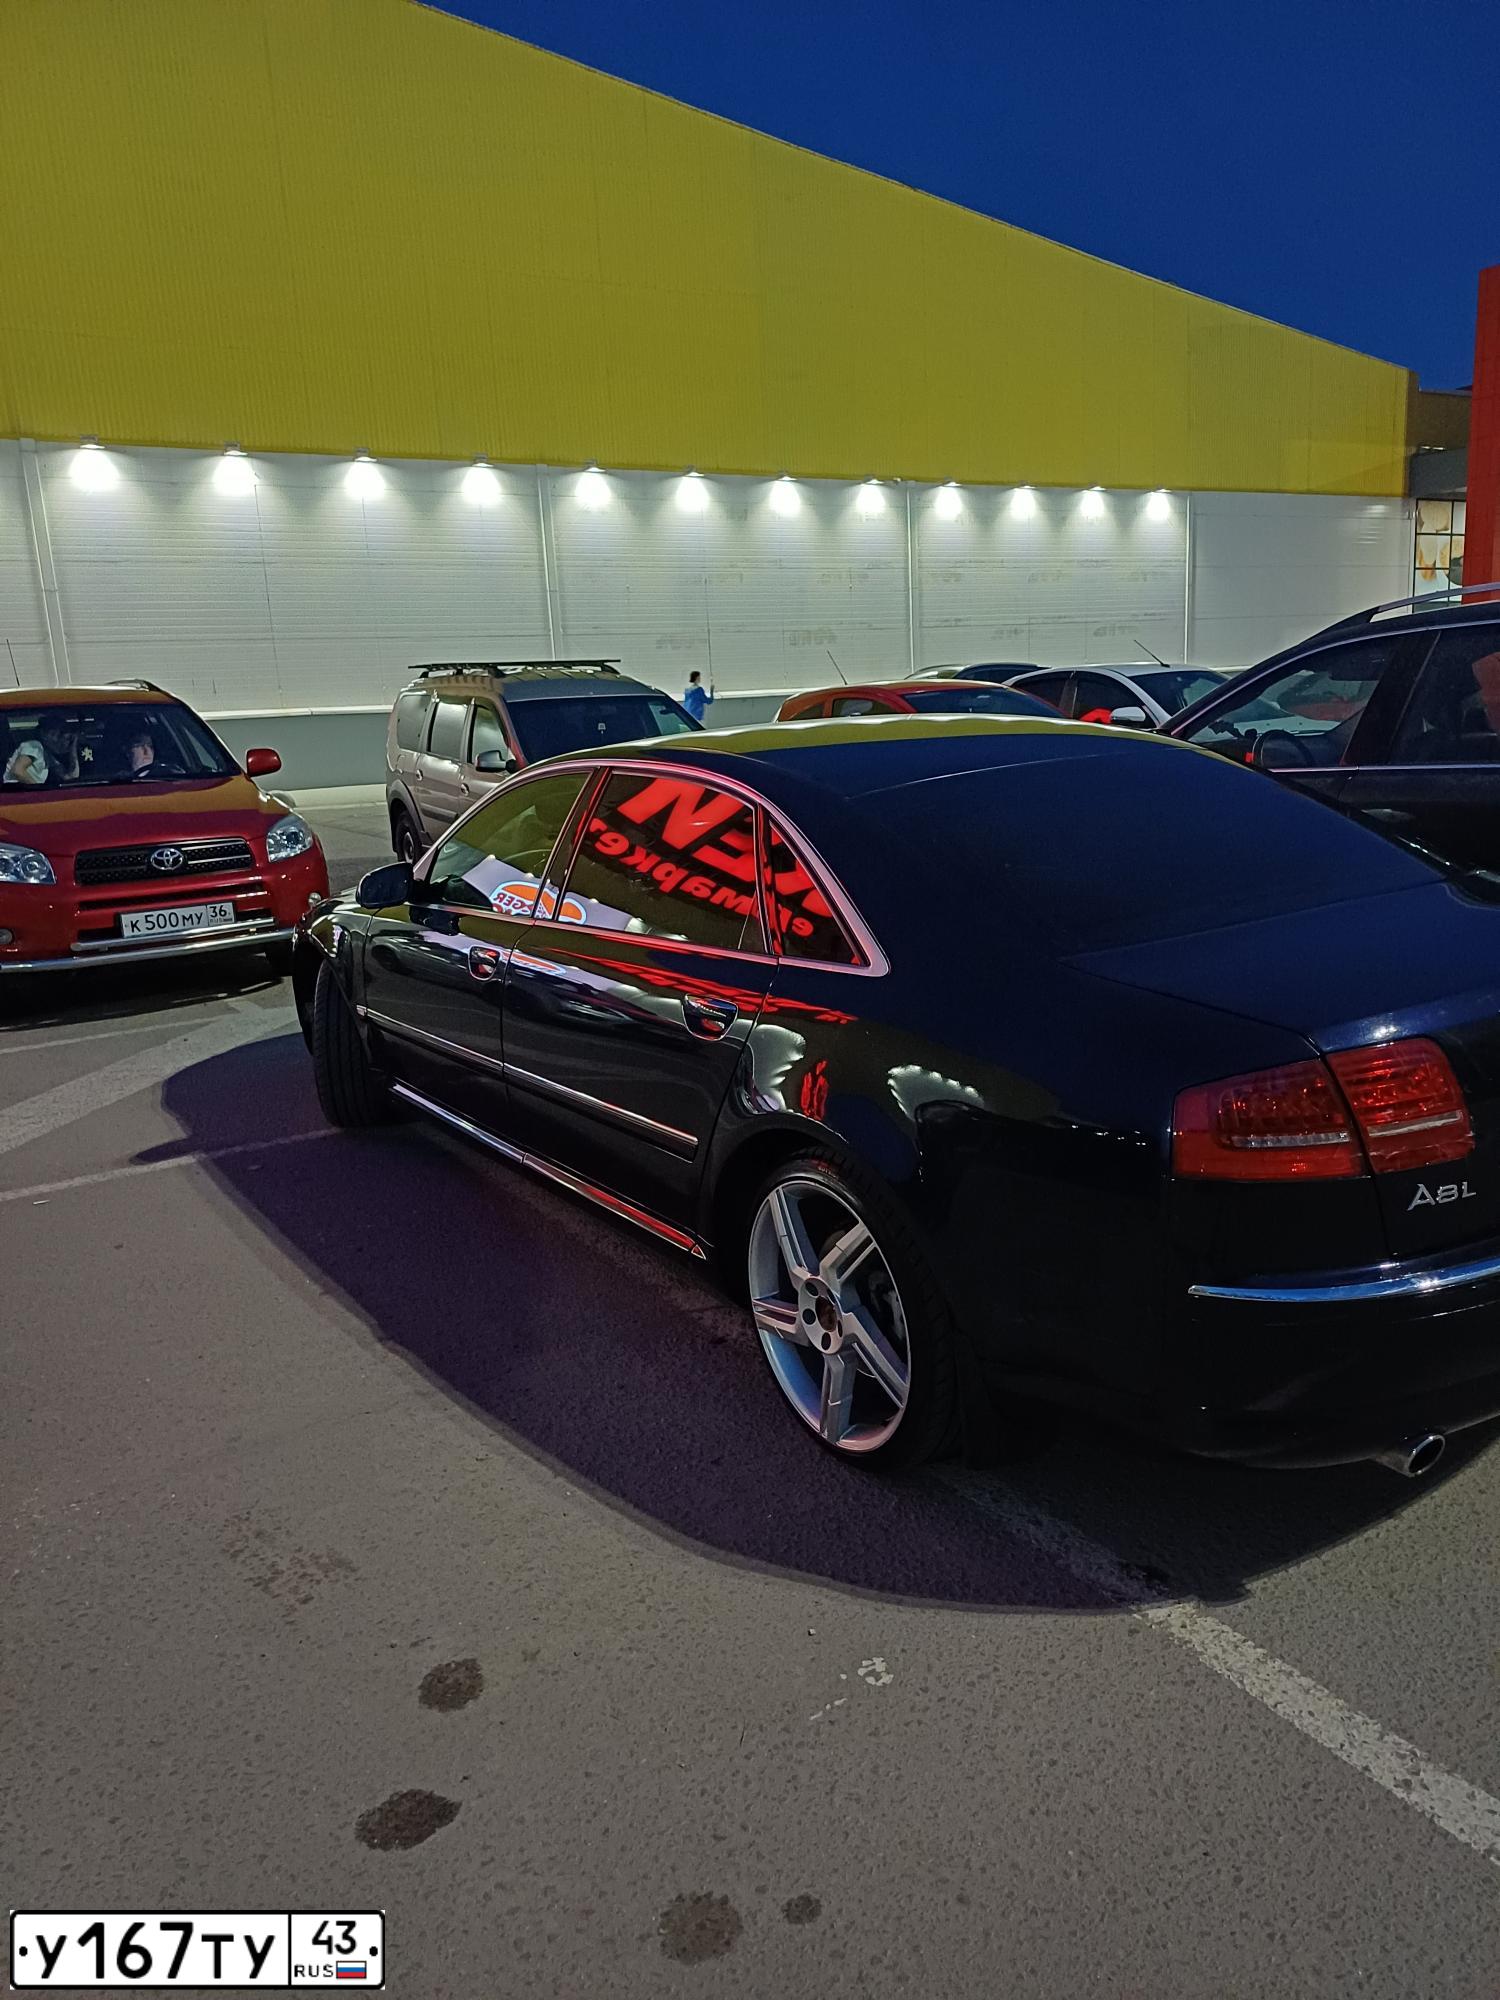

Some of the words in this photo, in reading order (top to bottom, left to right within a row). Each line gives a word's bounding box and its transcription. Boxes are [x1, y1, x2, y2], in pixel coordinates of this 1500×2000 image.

[130, 912, 204, 933] К500МУ
[209, 905, 227, 918] 36
[1407, 1181, 1477, 1211] A8L
